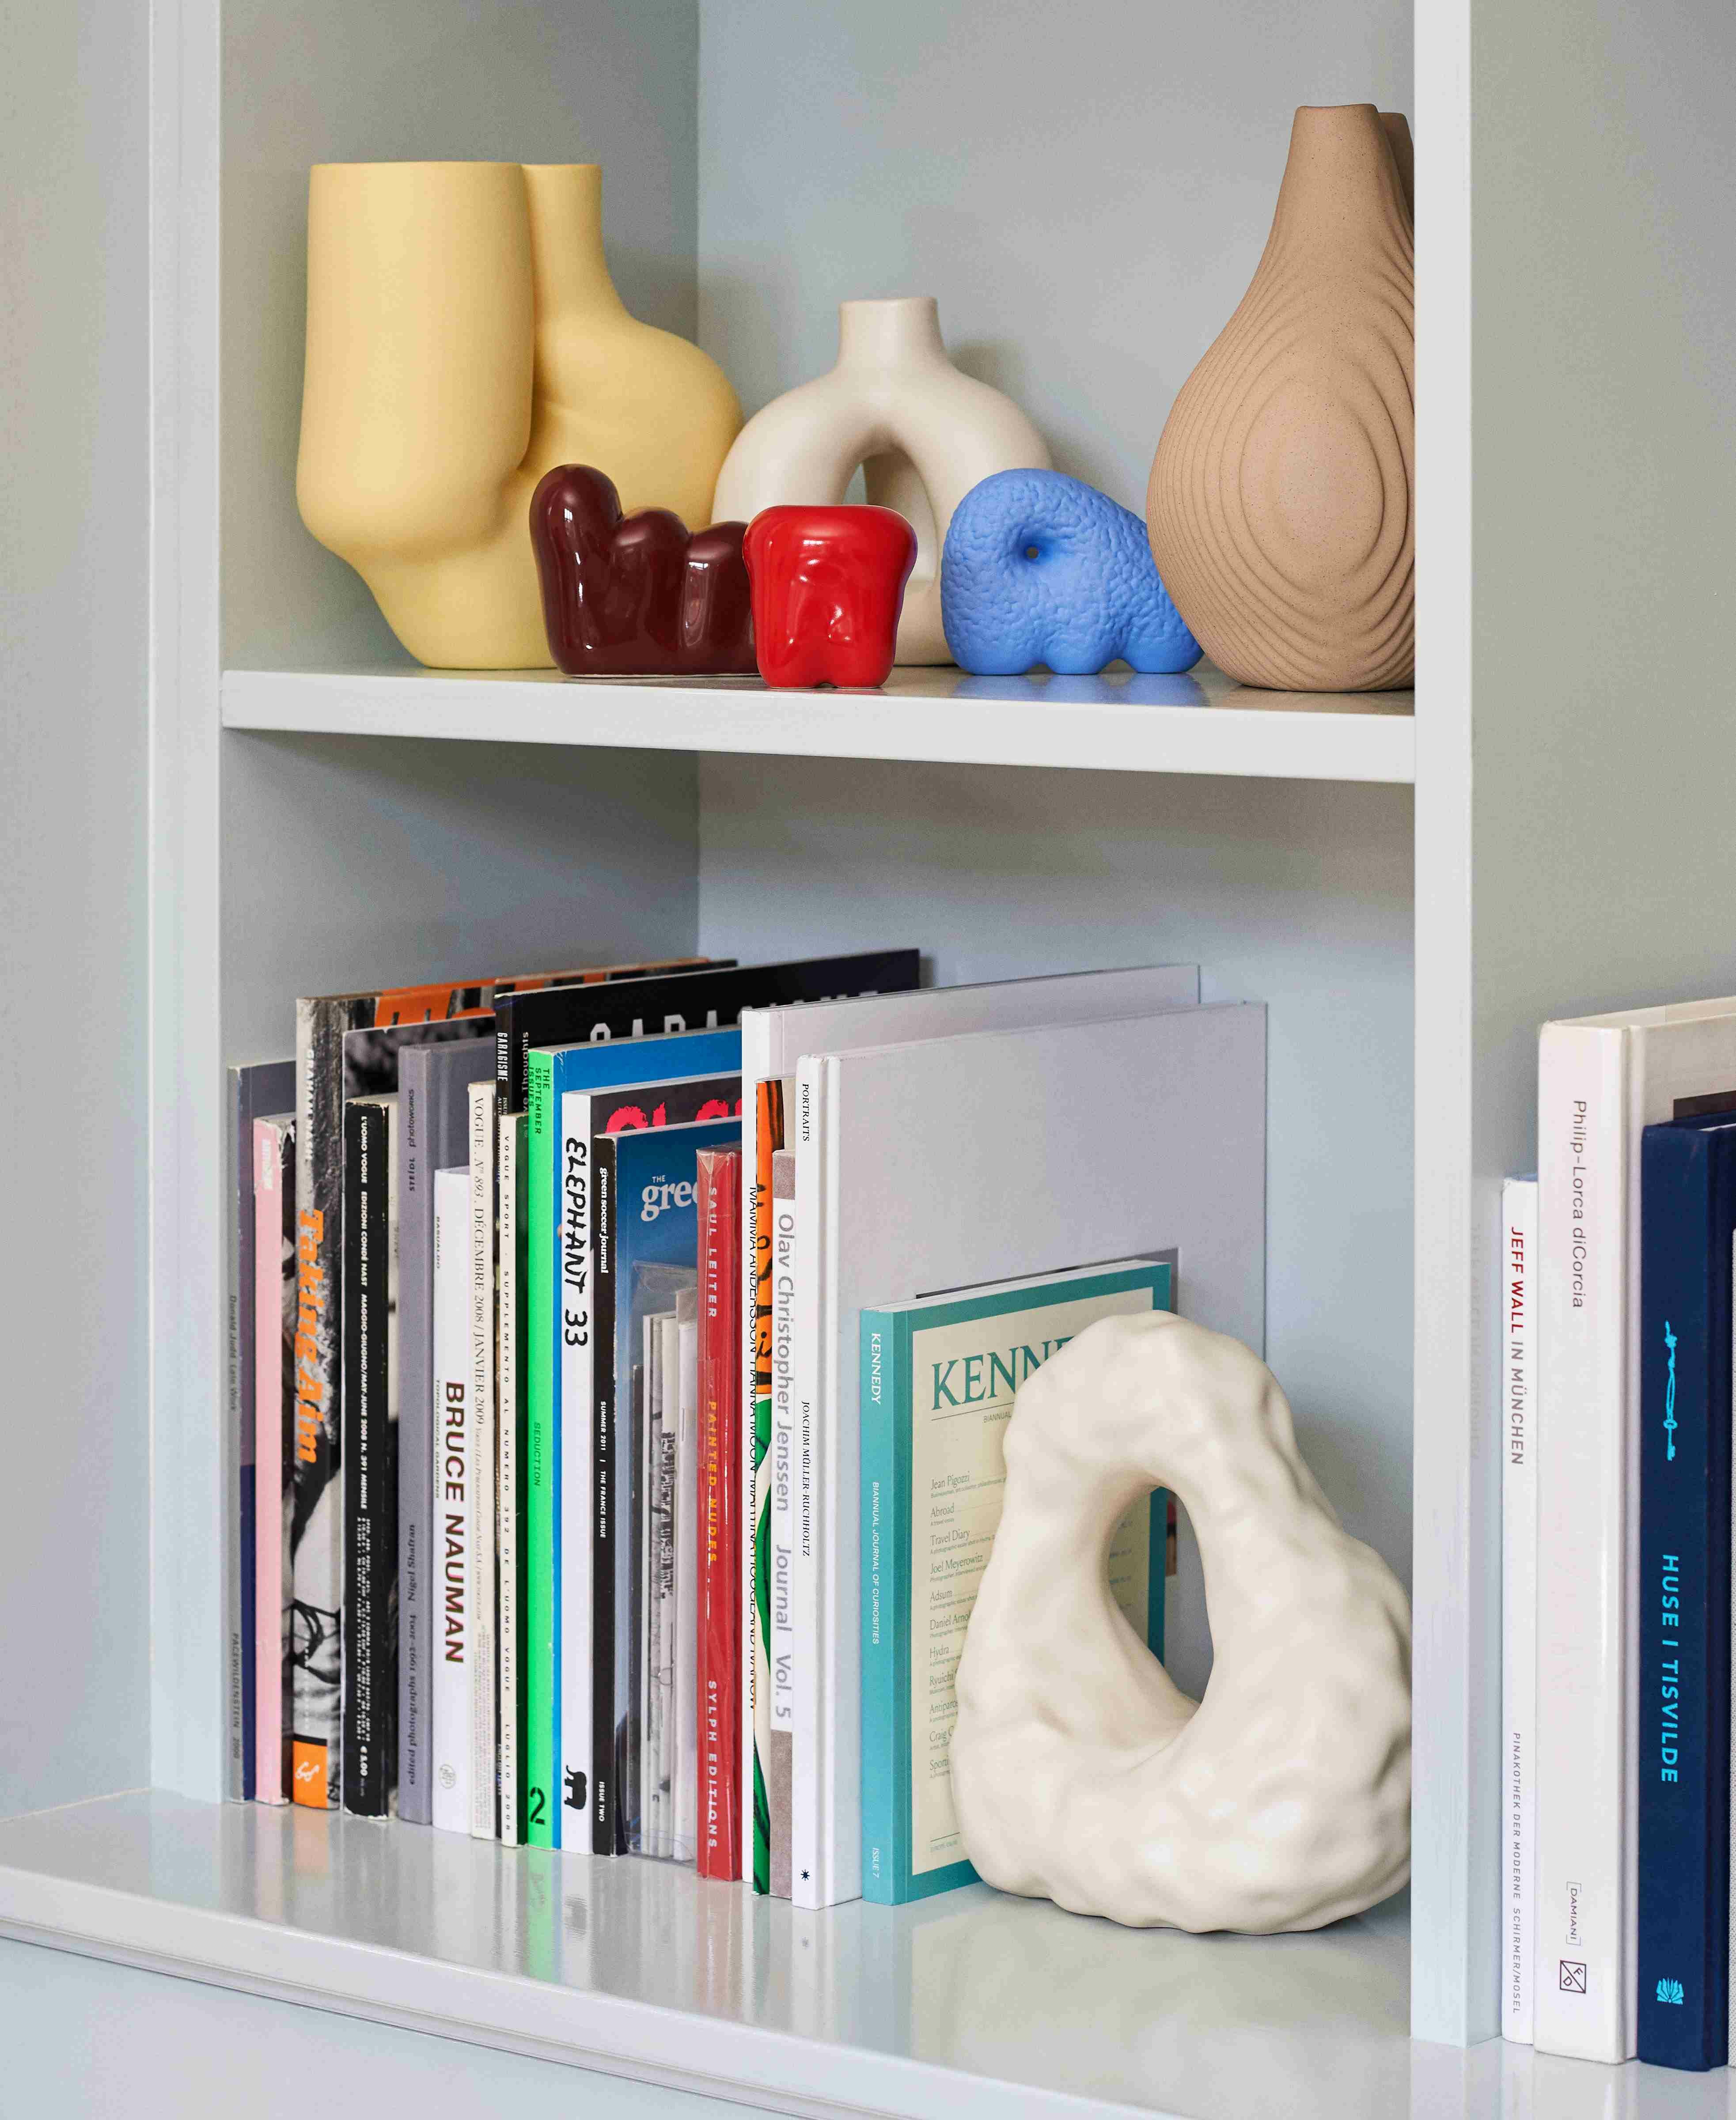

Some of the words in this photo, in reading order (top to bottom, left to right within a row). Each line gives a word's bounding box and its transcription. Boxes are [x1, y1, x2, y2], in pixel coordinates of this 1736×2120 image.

[497, 1032, 508, 1081] GARAGISME
[305, 1120, 313, 1159] NASH
[474, 1098, 485, 1147] VOGUE
[599, 1167, 608, 1198] green
[652, 1175, 666, 1183] THE
[1569, 1100, 1587, 1219] Philip-Lorca
[474, 1176, 485, 1198] 893
[641, 1181, 697, 1222] gre
[565, 1137, 588, 1294] ELEPHANT
[708, 1187, 717, 1236] SAUL
[360, 1231, 369, 1261] CONDÉ
[474, 1208, 486, 1291] DÉCEMBRE
[599, 1234, 609, 1273] journal
[778, 1214, 795, 1268] Olav
[1511, 1227, 1524, 1273] JEFF
[295, 1209, 325, 1364] Taking
[708, 1248, 717, 1317] LEITER
[1572, 1227, 1587, 1308] diCorcia
[474, 1295, 485, 1322] 2008
[565, 1309, 588, 1346] 33
[1511, 1280, 1524, 1333] WALL
[473, 1331, 485, 1393] JANVIER
[773, 1276, 795, 1414] Christopher
[871, 1332, 881, 1404] KENNEDY
[1511, 1340, 1523, 1360] IN
[297, 1367, 323, 1463] Aim
[474, 1396, 485, 1424] 2009
[504, 1398, 509, 1414] AL
[801, 1401, 810, 1446] JOACHIM
[1511, 1368, 1527, 1465] MÜNCHEN
[445, 1382, 465, 1502] BRUCE
[708, 1401, 717, 1486] PAINTED
[776, 1421, 793, 1511] Jenssen
[931, 1479, 945, 1490] Jean
[947, 1470, 970, 1488] Pigozzi
[802, 1448, 812, 1557] MÜLLER-RUCHHOLTZ
[930, 1502, 954, 1518] Abroad
[407, 1525, 416, 1569] Shafran
[708, 1498, 717, 1562] NUDES
[930, 1531, 950, 1546] Travel
[952, 1529, 970, 1541] Diary
[504, 1548, 509, 1565] DE
[930, 1561, 944, 1575] Joel
[945, 1552, 983, 1571] Meyerowitz
[407, 1571, 417, 1602] Nigel
[445, 1513, 465, 1663] NAUMAN
[776, 1544, 793, 1632] Journal
[872, 1574, 879, 1586] OF
[930, 1590, 952, 1602] Adsum
[1662, 1554, 1679, 1627] HUSE
[929, 1614, 951, 1630] Daniel
[953, 1609, 971, 1624] Arnol
[776, 1654, 792, 1695] Vol.
[929, 1643, 949, 1660] Hydra
[407, 1675, 417, 1746] photographs
[708, 1680, 717, 1742] SYLPH
[776, 1705, 792, 1719] 5
[1661, 1659, 1679, 1783] TISVILDE
[929, 1728, 947, 1742] Craig
[408, 1749, 416, 1785] edited
[530, 1786, 546, 1825] 2
[708, 1753, 717, 1848] EDITIONS
[1512, 1908, 1521, 2014] SCHIRMER/MOSEL
